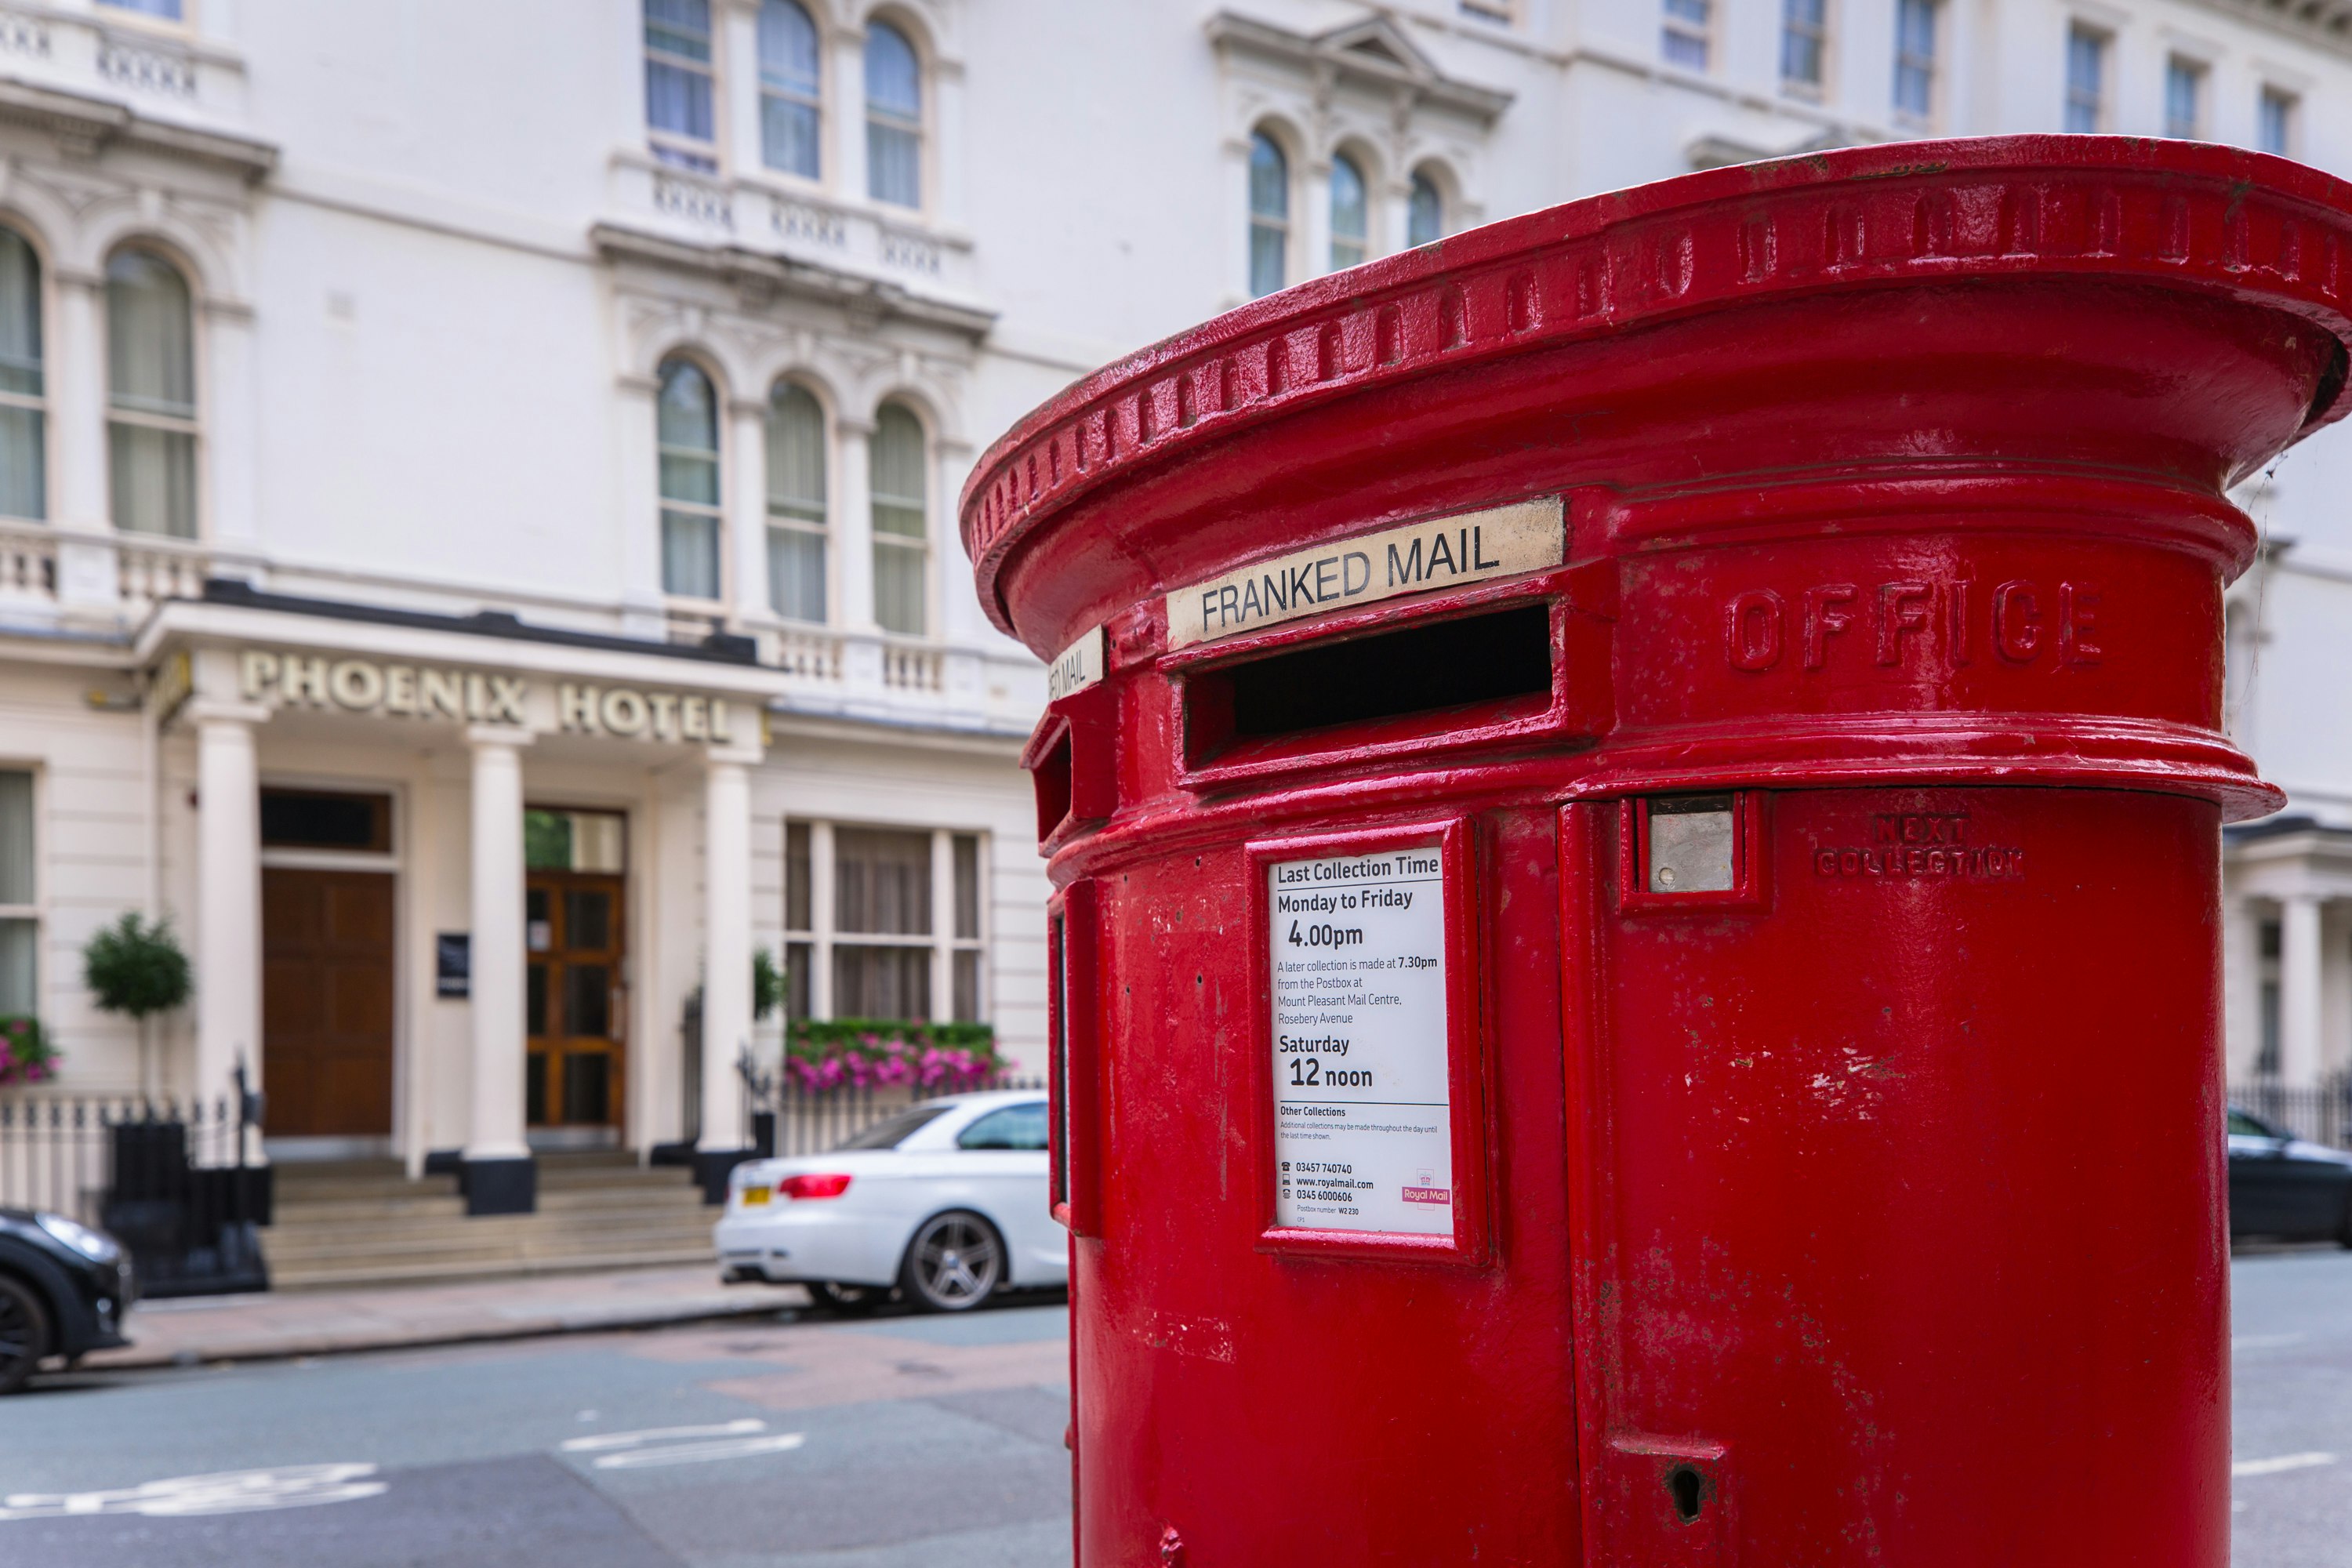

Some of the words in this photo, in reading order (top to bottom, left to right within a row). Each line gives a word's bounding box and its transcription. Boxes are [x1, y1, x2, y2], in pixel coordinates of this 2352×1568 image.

[1202, 551, 1370, 632] FRANKED
[1388, 526, 1499, 586] MAIL
[1725, 580, 2103, 671] OFFICE
[1062, 650, 1085, 695] MAIL
[241, 651, 525, 724] PHOENIX
[559, 684, 732, 743] HOTEL
[1876, 813, 1970, 843] NEXT
[1278, 866, 1310, 884] Last
[1314, 859, 1391, 880] Collection
[1396, 856, 1439, 875] Time
[1815, 848, 2024, 877] COLLECTION
[1279, 894, 1337, 914] Monday
[1341, 893, 1356, 909] to
[1362, 889, 1413, 909] Friday
[1288, 920, 1363, 950] 4.00pm
[1277, 962, 1283, 972] A
[1286, 961, 1305, 972] later
[1307, 960, 1348, 971] collection
[1350, 959, 1356, 970] is
[1359, 957, 1385, 970] made
[1387, 959, 1396, 968] at
[1398, 956, 1437, 970] 7.30pm
[1278, 979, 1298, 989] from
[1300, 978, 1314, 989] the
[1316, 977, 1352, 989] Postbox
[1353, 978, 1363, 988] at
[1278, 996, 1306, 1007] Mount
[1308, 995, 1345, 1007] Pleasant
[1348, 994, 1367, 1005] Mail
[1368, 993, 1402, 1005] Centre,
[1279, 1013, 1319, 1026] Rosebery
[1319, 1012, 1353, 1024] Avenue
[1279, 1035, 1349, 1056] Saturday
[1290, 1058, 1319, 1086] 12
[1325, 1069, 1372, 1087] noon
[1280, 1105, 1301, 1115] Other
[1303, 1106, 1345, 1116] Collections
[1370, 1124, 1402, 1133] throughout
[1413, 1125, 1424, 1134] day
[1296, 1163, 1320, 1172] 03457
[1322, 1163, 1352, 1174] 740740
[1296, 1178, 1374, 1189] www.royalmail.com
[1297, 1189, 1316, 1200] 0345
[1318, 1191, 1352, 1202] 6000606
[1404, 1189, 1428, 1200] Royal
[1429, 1190, 1448, 1201] Mail
